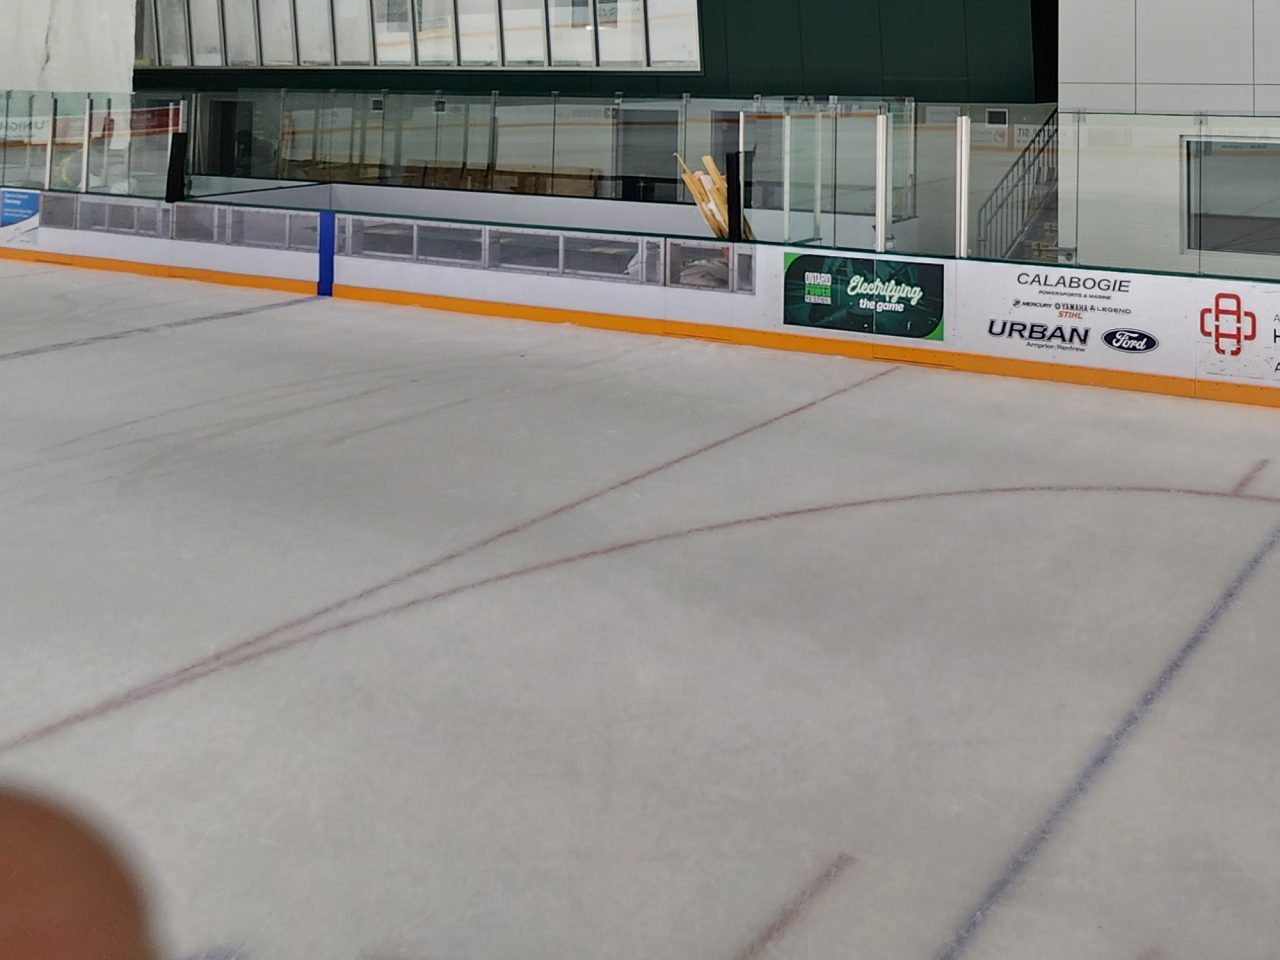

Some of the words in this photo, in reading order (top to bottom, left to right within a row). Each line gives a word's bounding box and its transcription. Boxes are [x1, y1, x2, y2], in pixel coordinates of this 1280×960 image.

[1017, 272, 1131, 293] CALABOGIE
[847, 275, 923, 306] Electrifying
[1039, 289, 1082, 299] POWERSPORTS
[859, 298, 875, 310] the
[876, 301, 905, 313] game
[1022, 300, 1052, 309] MERCURY
[1062, 302, 1088, 312] YAMAHA
[1057, 310, 1083, 320] STIHL
[1097, 306, 1132, 315] LEGEND
[987, 318, 1091, 346] URBAN
[1112, 330, 1147, 351] Ford
